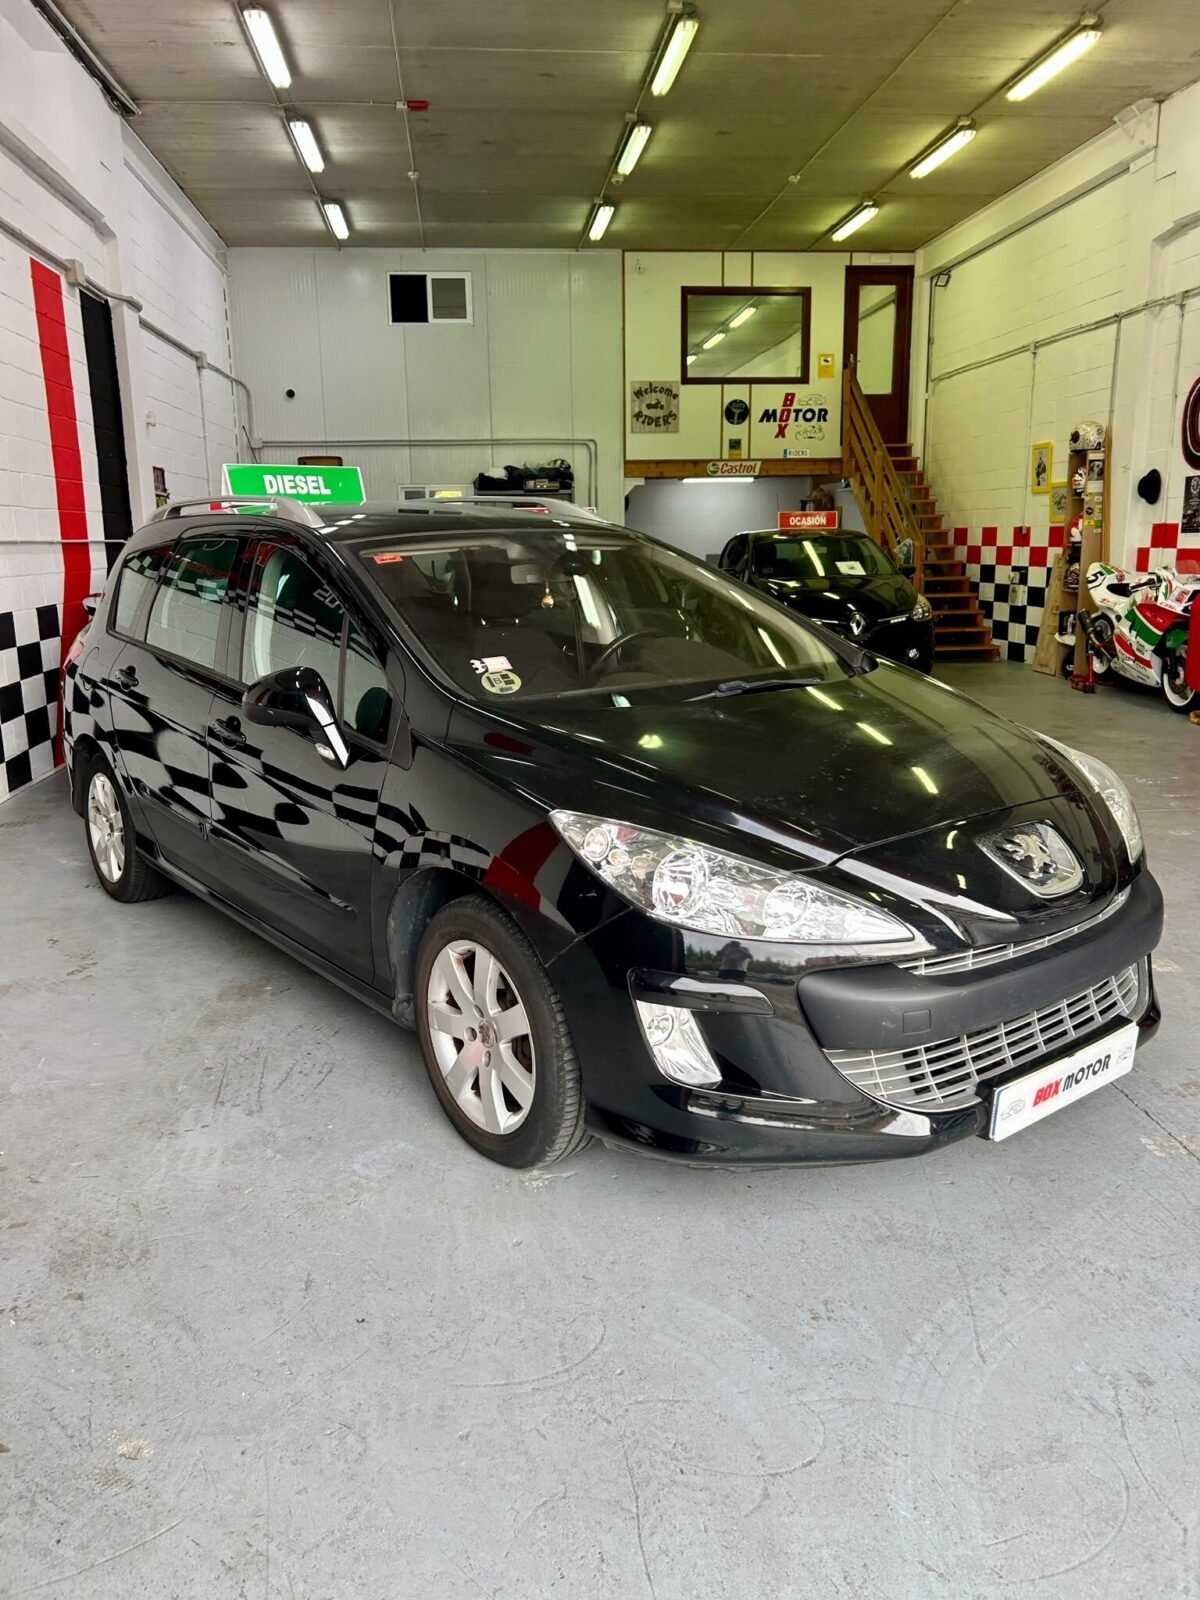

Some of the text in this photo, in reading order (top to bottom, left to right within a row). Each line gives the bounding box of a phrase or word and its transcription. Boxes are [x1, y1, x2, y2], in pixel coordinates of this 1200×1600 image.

[633, 381, 679, 400] Welcome
[633, 410, 677, 427] RIDERS
[788, 449, 808, 457] RIDERS
[720, 462, 758, 474] Castrol
[263, 474, 332, 495] DIESEL
[789, 514, 827, 526] OCASIÓN
[1032, 1053, 1112, 1108] BOX MOTOR
